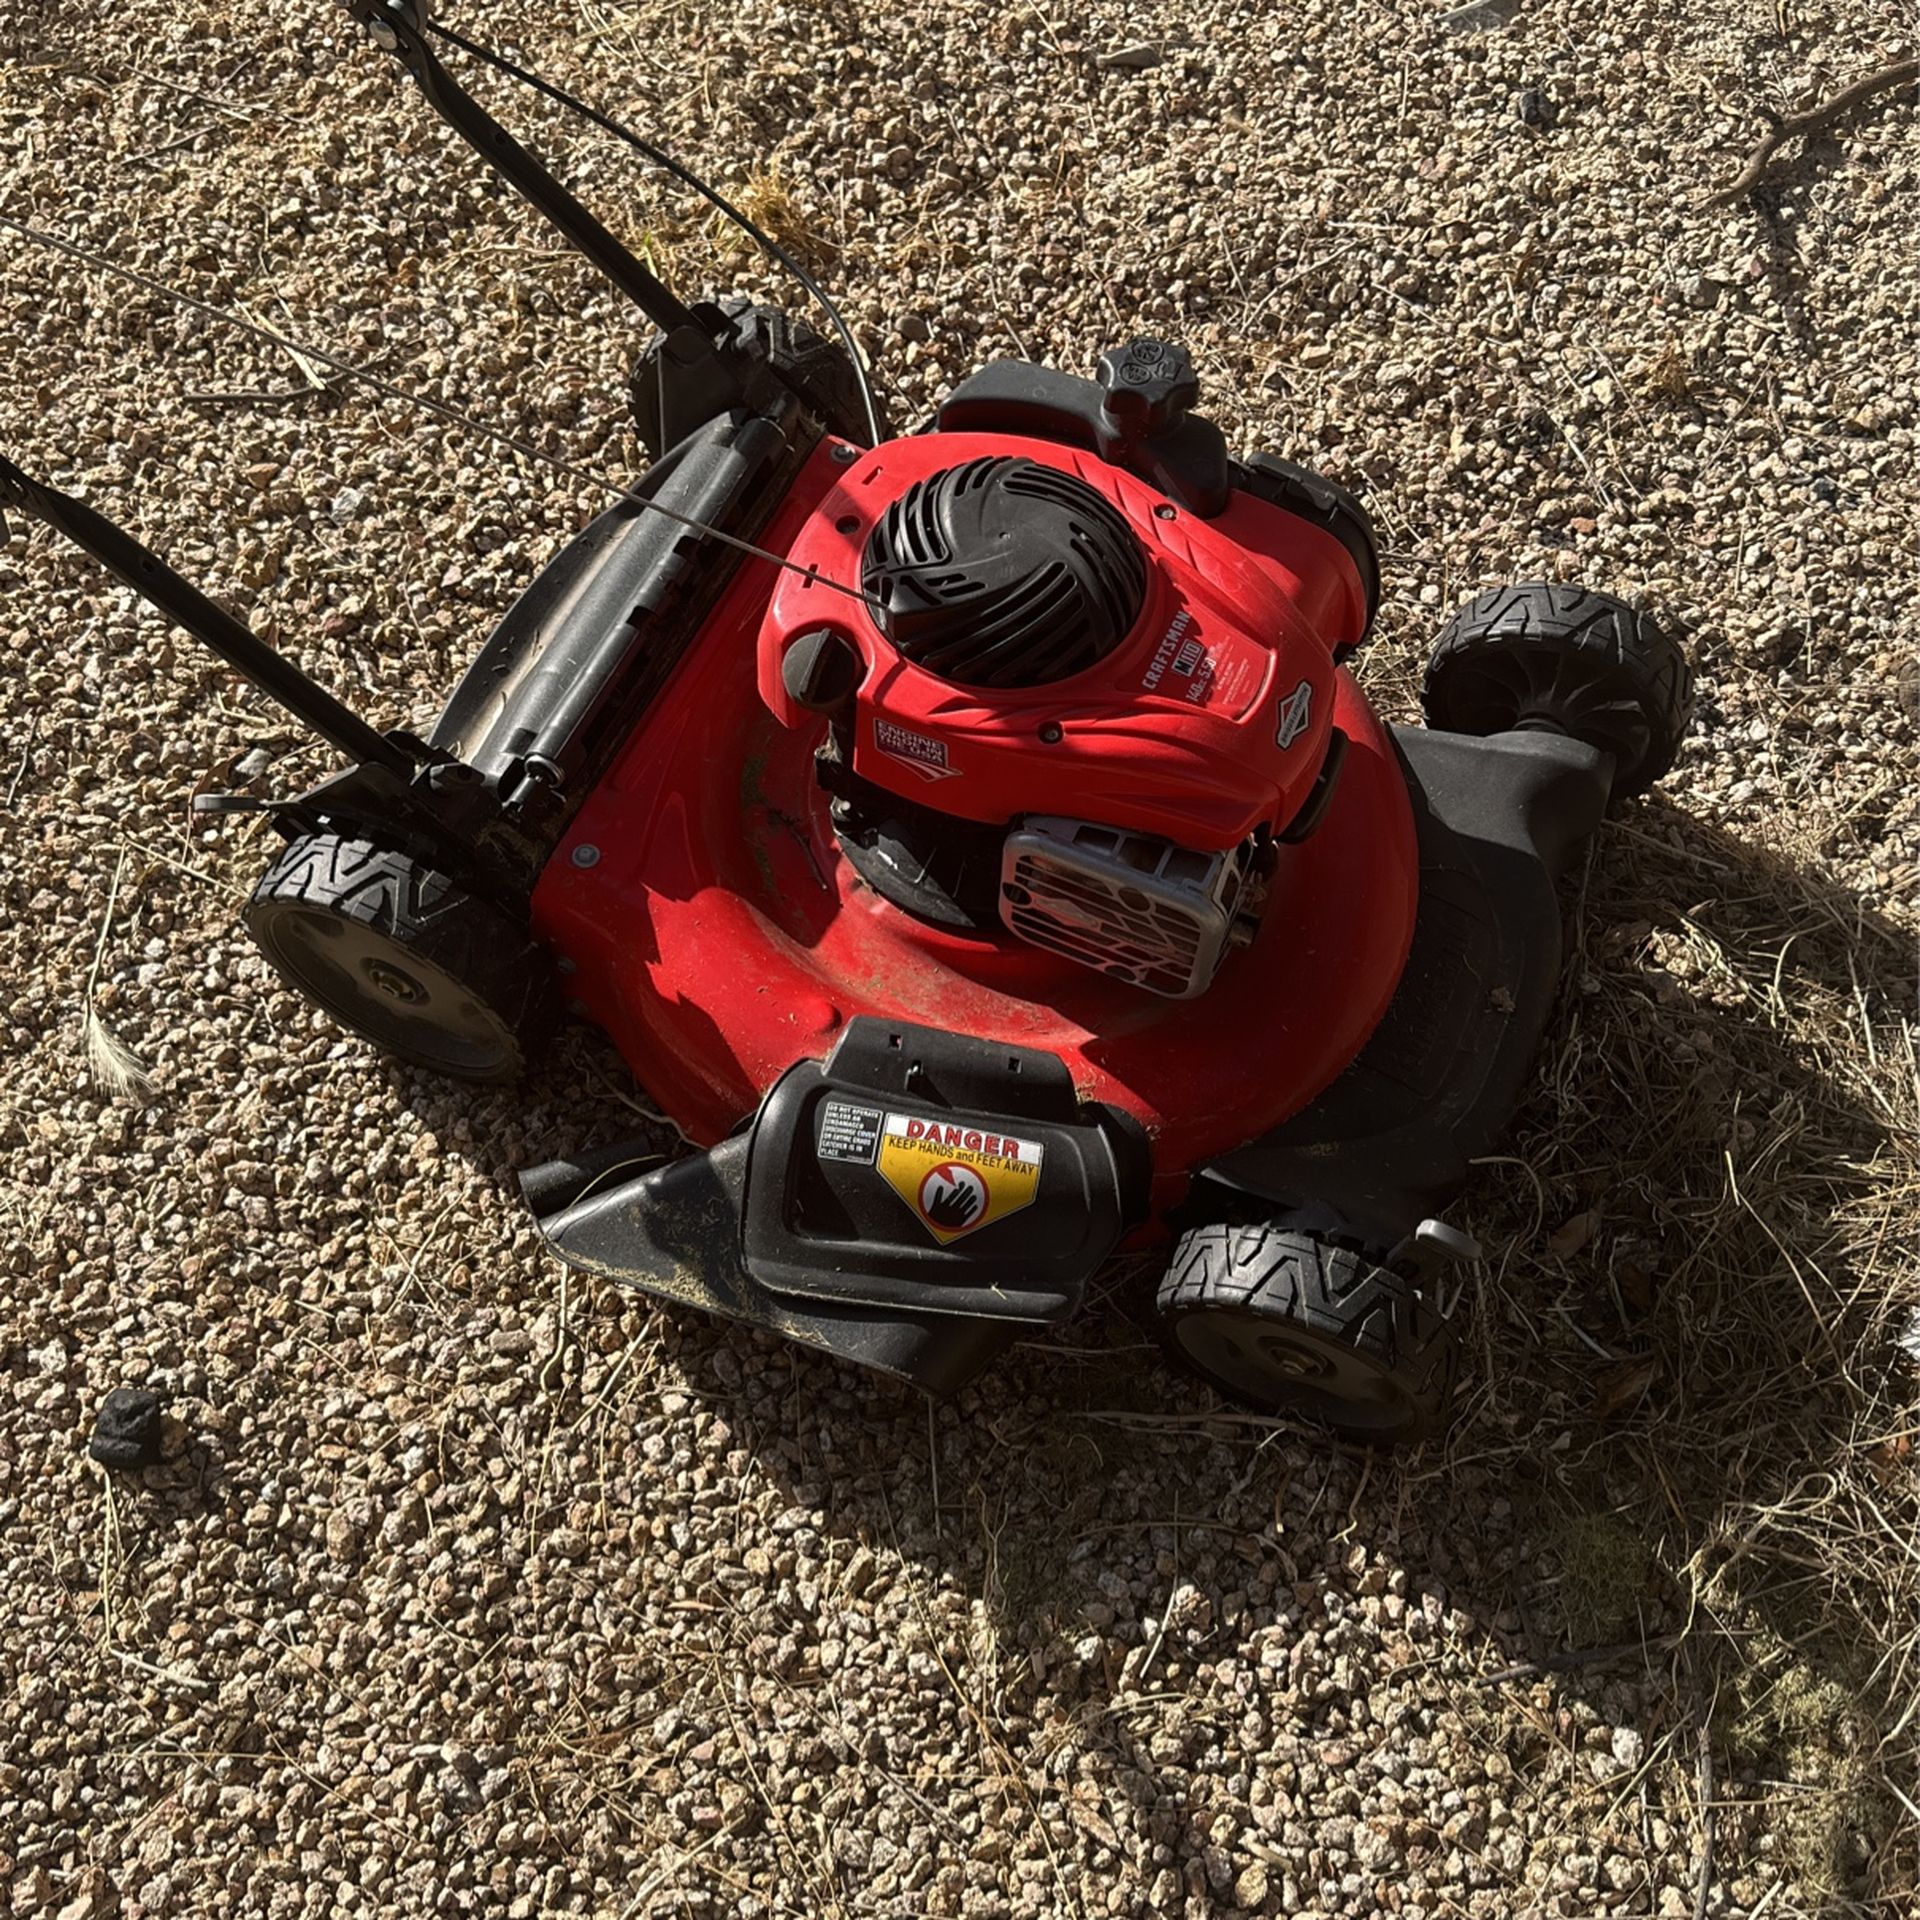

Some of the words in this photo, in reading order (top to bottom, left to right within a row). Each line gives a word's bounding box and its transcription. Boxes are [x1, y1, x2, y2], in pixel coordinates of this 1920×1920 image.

[1142, 610, 1191, 690] CRAFTSMAN
[1173, 641, 1203, 676] M110
[878, 721, 941, 749] ENGINE
[878, 728, 920, 750] MADE
[927, 745, 943, 757] IN
[880, 734, 905, 750] THE
[910, 746, 943, 763] USA
[852, 1109, 878, 1118] OPERATE
[857, 1130, 876, 1138] COVER
[906, 1119, 1021, 1159] DANGER
[820, 1147, 839, 1156] PLACE
[888, 1135, 917, 1150] KEEP
[918, 1141, 954, 1158] HANDS
[956, 1151, 974, 1162] and
[976, 1153, 1003, 1169] FEET
[1004, 1159, 1036, 1176] AWAY
